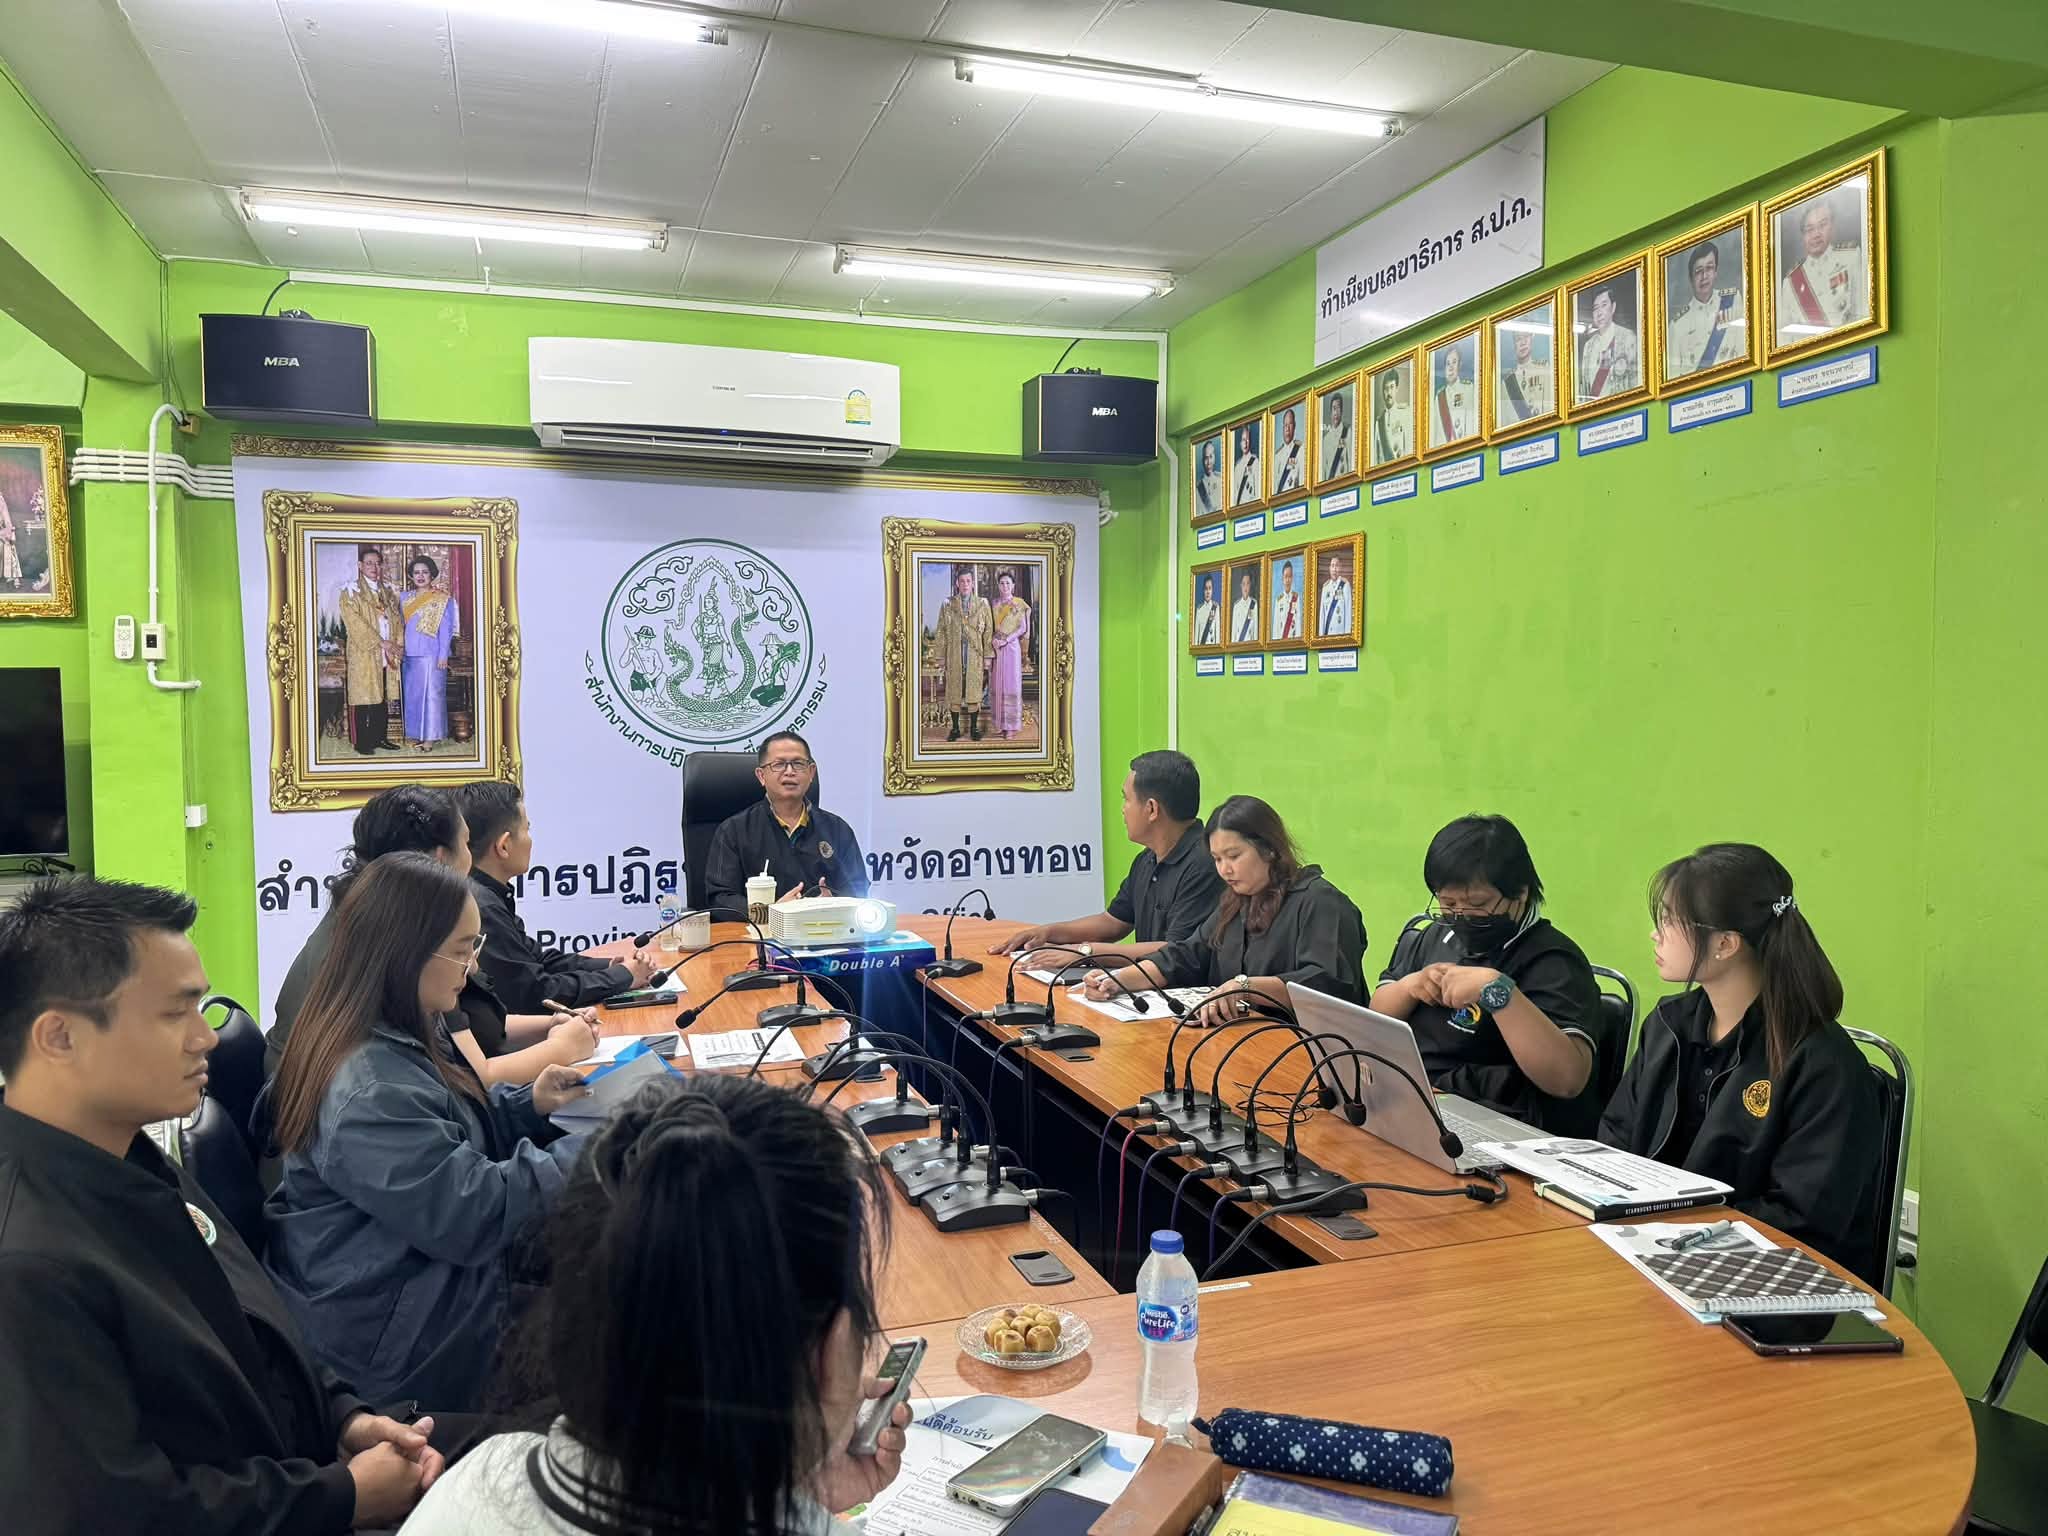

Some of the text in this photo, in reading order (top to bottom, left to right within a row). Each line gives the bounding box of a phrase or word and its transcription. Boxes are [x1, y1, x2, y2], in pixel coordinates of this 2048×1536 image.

[1321, 197, 1532, 319] ทำเนียบเลขาธิการ ส.ป.ก.
[264, 356, 300, 367] MBA
[1092, 407, 1118, 416] MBA
[829, 957, 884, 972] Double
